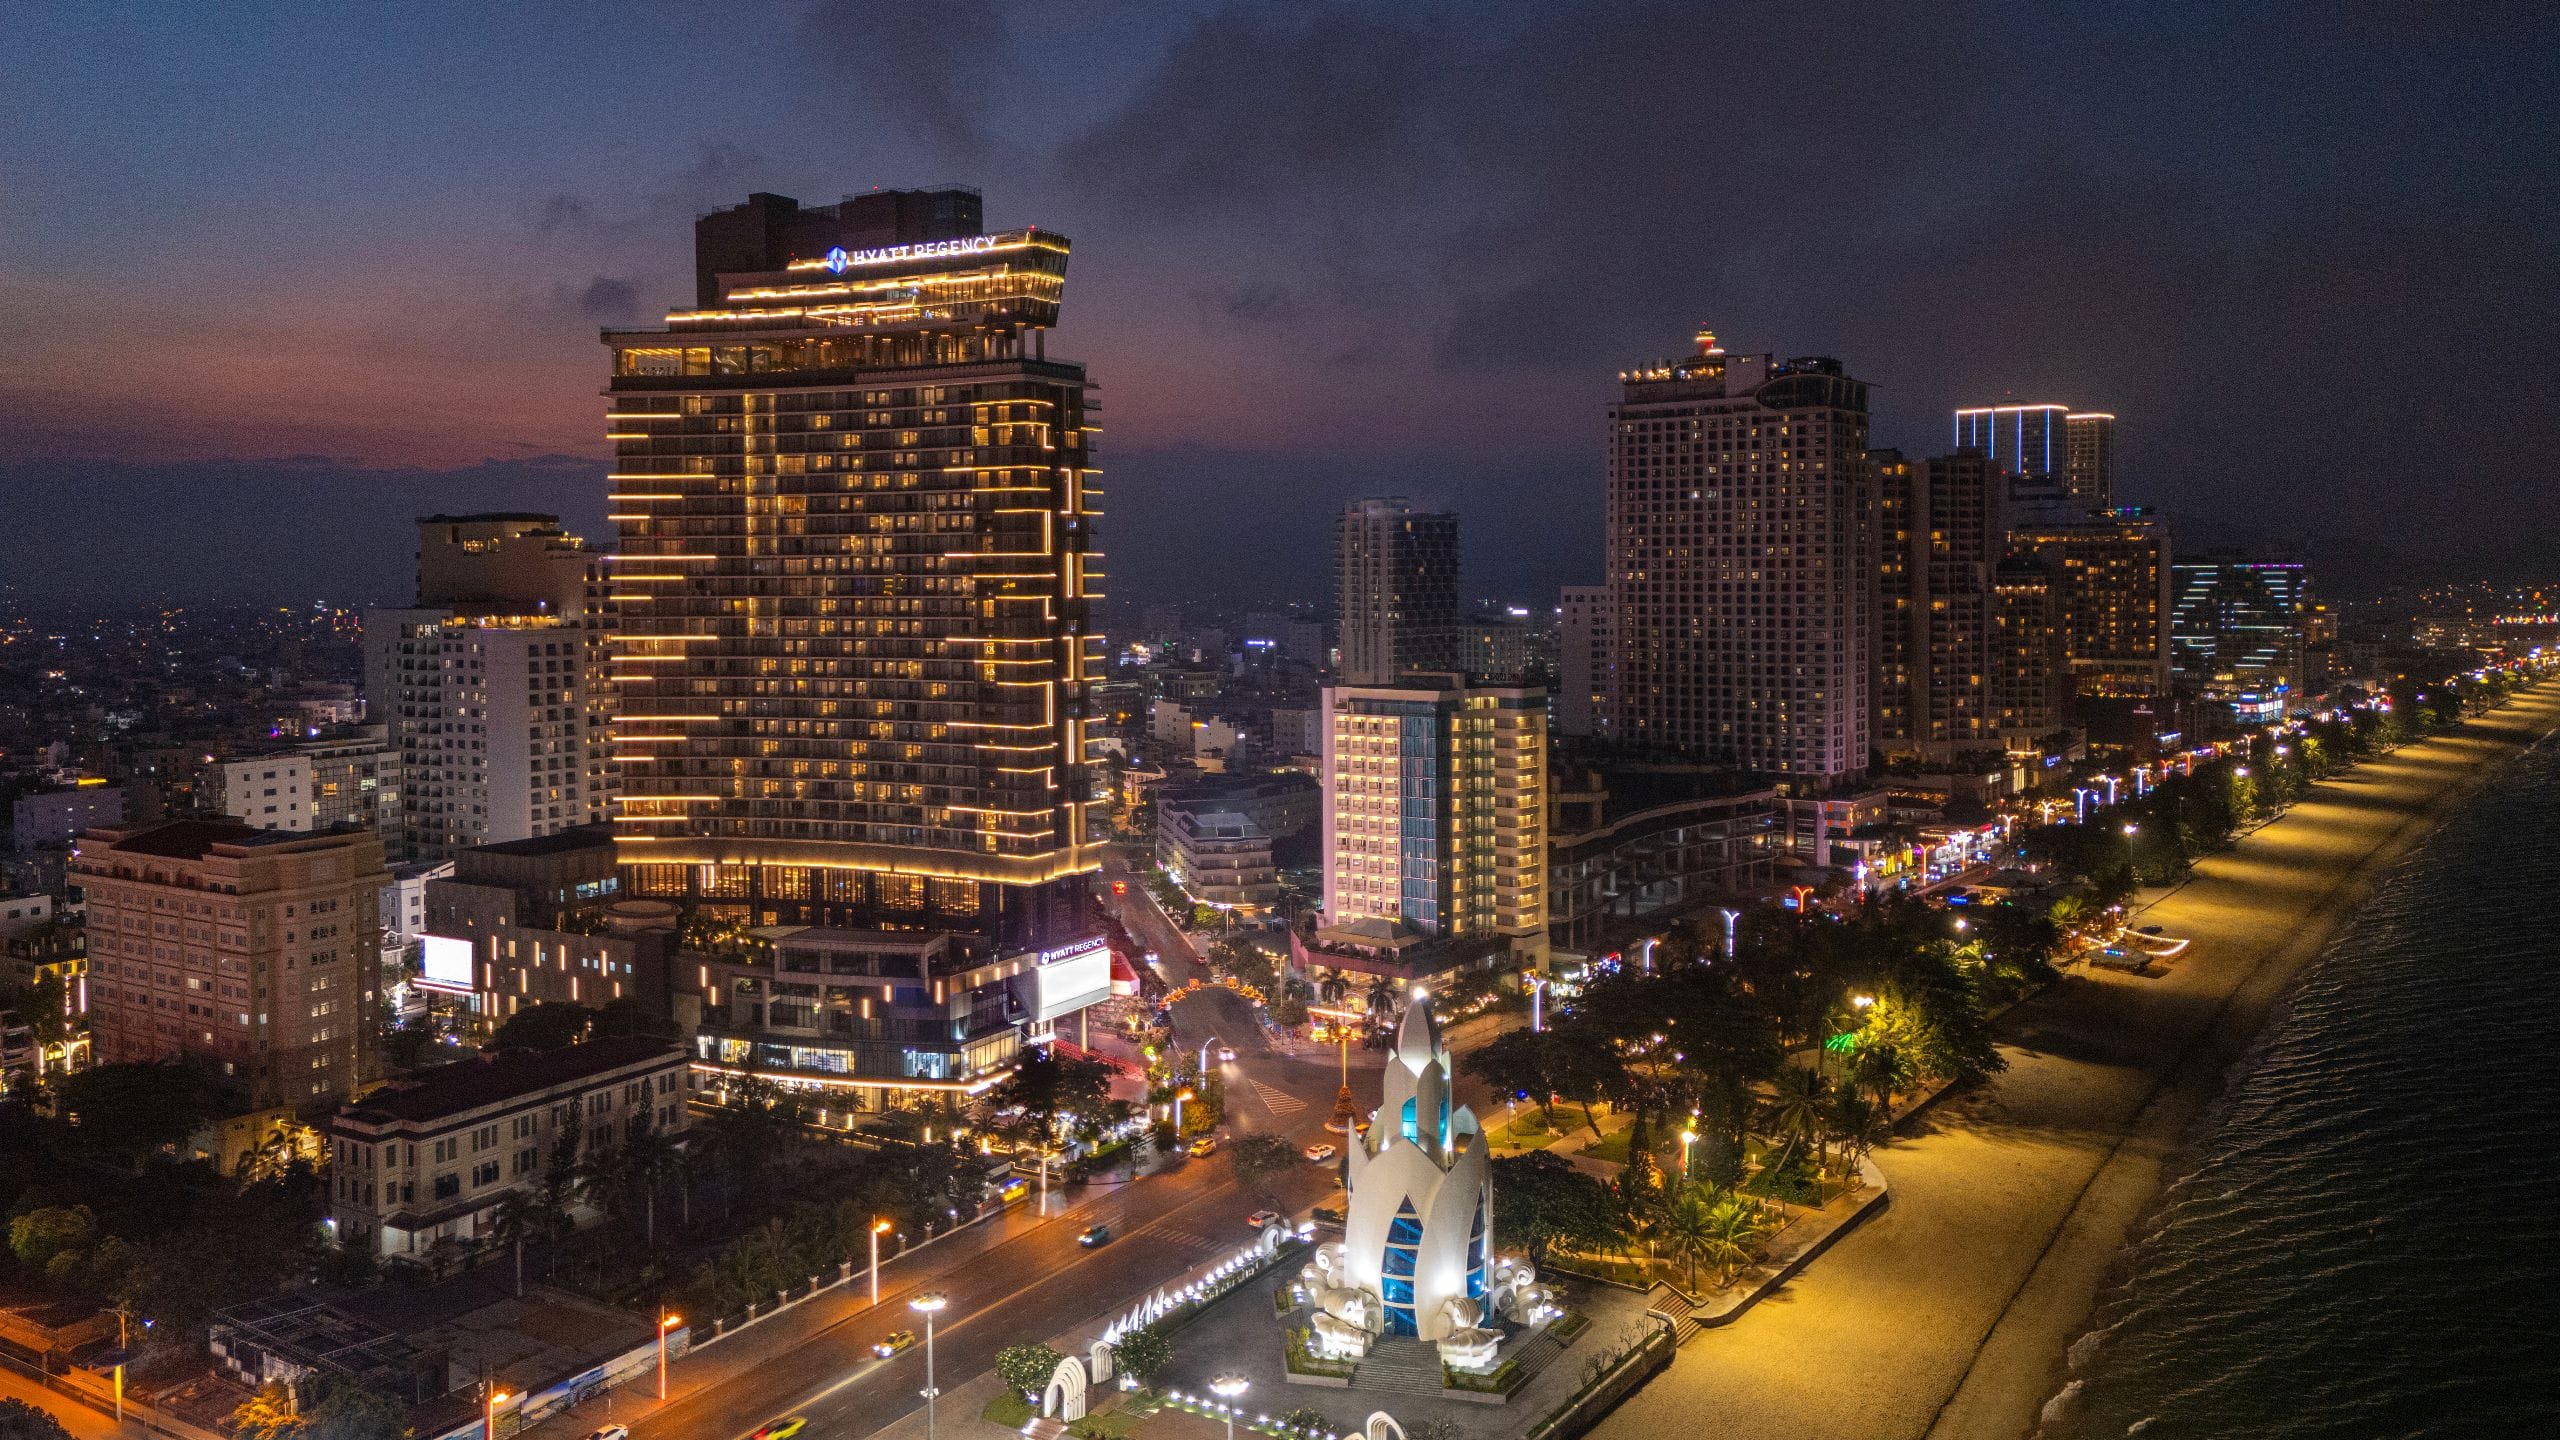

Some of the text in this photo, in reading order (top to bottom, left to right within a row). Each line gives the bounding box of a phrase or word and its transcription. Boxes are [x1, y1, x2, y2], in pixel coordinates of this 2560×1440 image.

[854, 237, 996, 265] HYATT REGENCY
[1051, 938, 1104, 960] HYATT REGENCY
